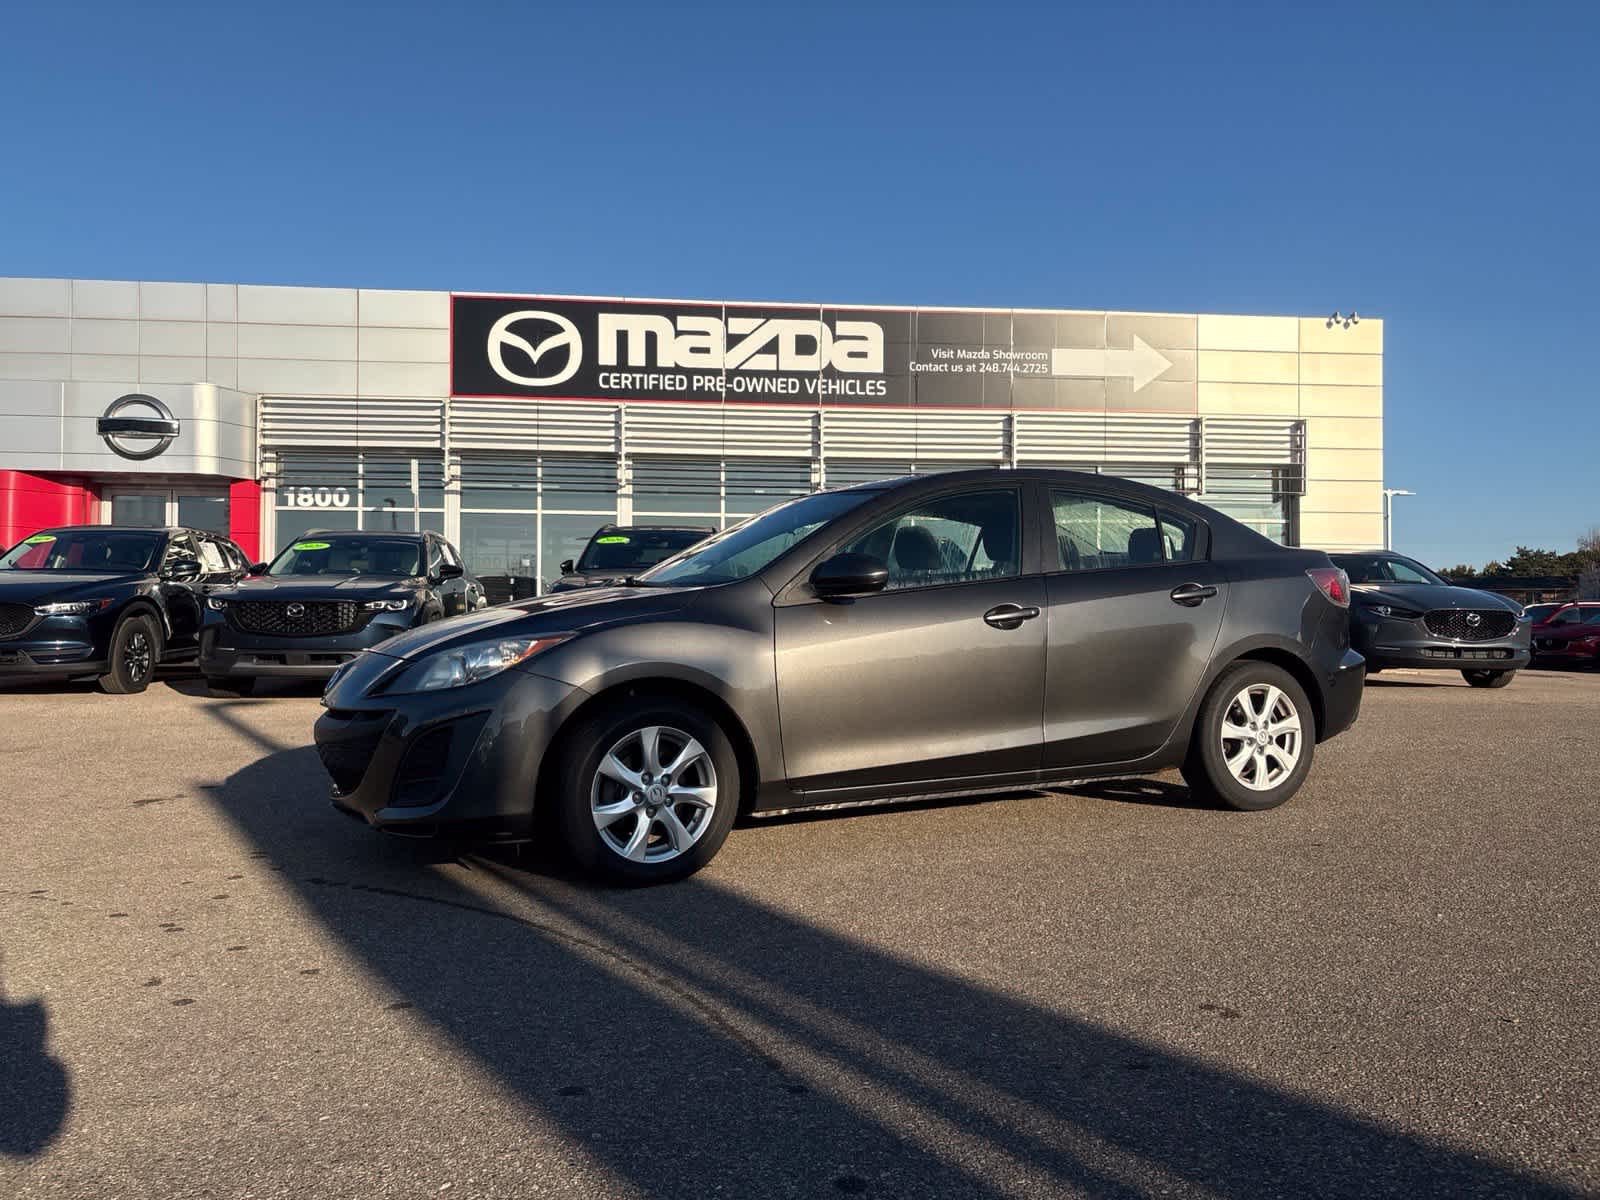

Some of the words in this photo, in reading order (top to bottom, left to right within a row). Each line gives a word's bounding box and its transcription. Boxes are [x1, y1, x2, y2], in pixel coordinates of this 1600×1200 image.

[931, 348, 954, 359] Visit
[957, 349, 990, 360] Mazda
[993, 350, 1048, 361] Showroom
[909, 361, 948, 372] Contact
[951, 364, 964, 373] us
[966, 364, 977, 373] at
[979, 363, 1048, 374] 248.744.2725
[598, 373, 688, 391] CERTIFIED
[692, 375, 799, 394] PRE-OWNED
[805, 378, 887, 396] VEHICLES
[284, 487, 350, 507] 1800
